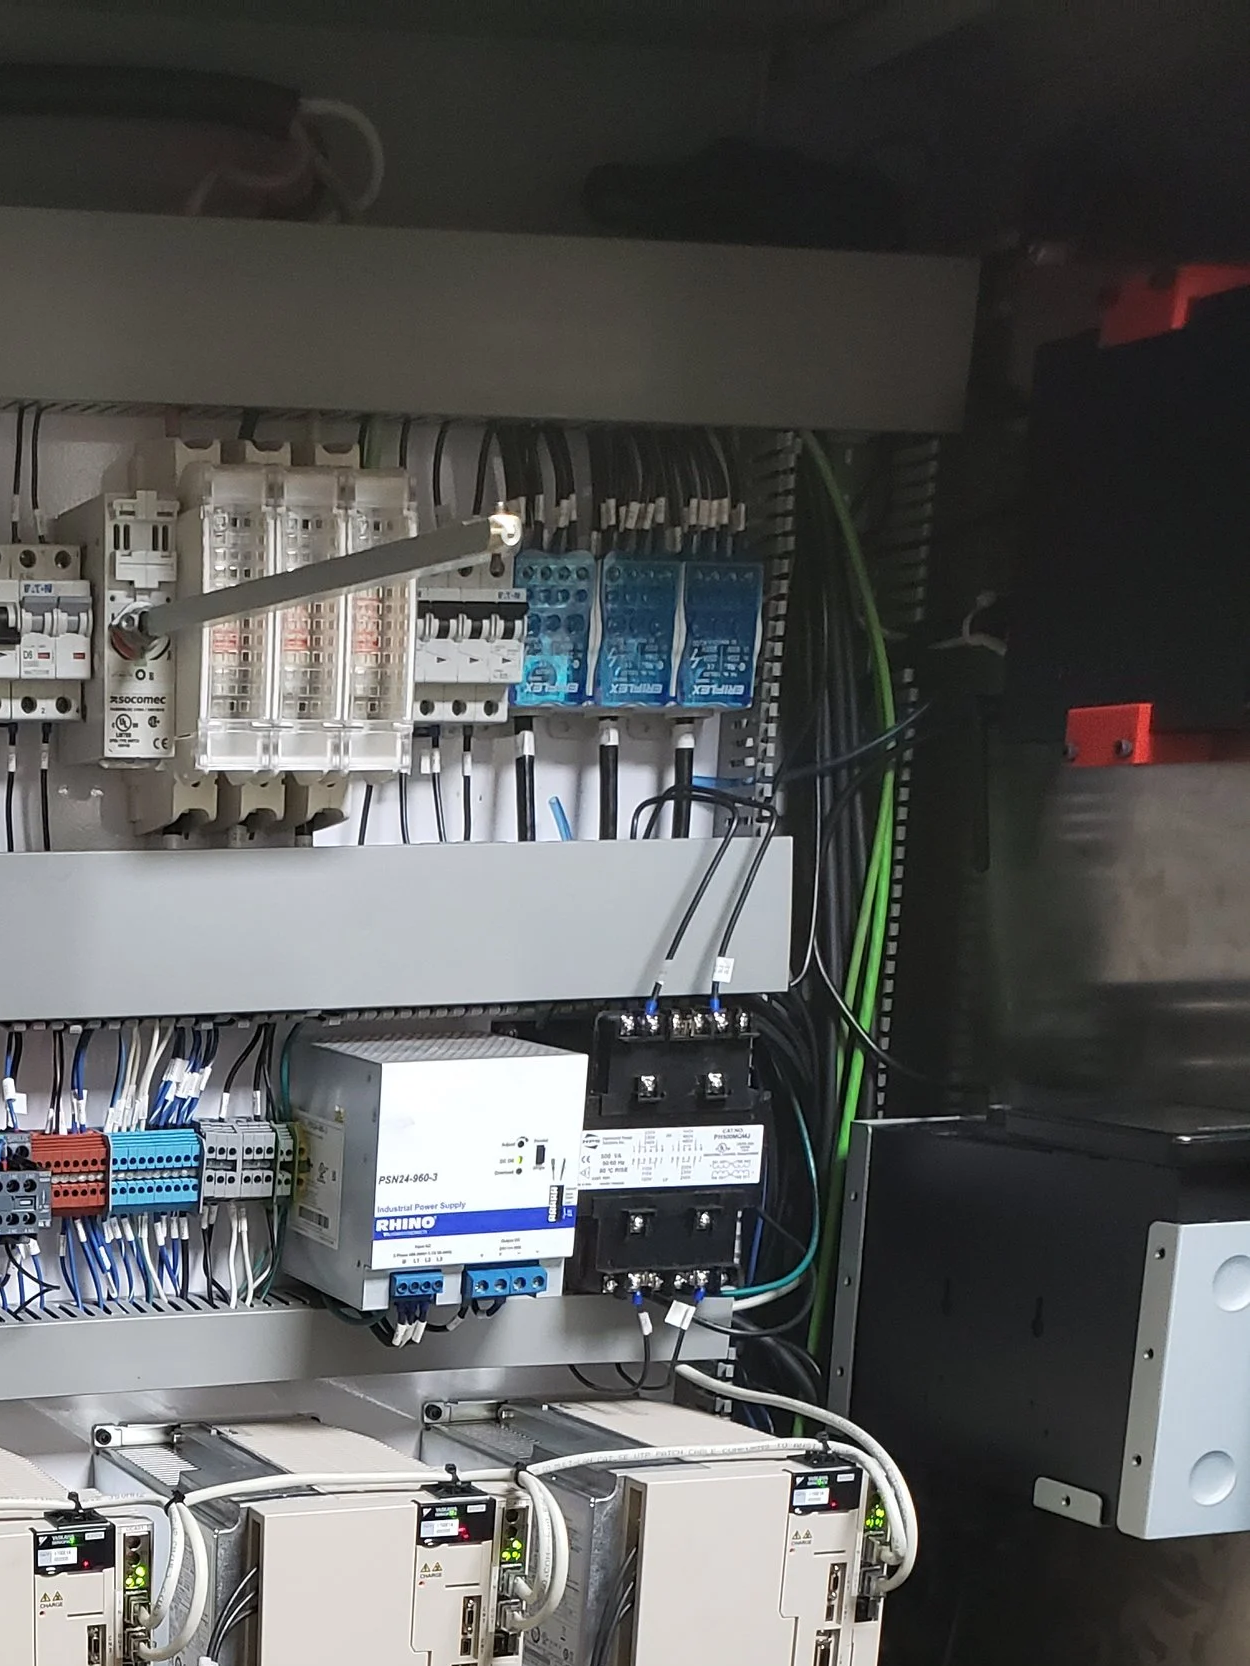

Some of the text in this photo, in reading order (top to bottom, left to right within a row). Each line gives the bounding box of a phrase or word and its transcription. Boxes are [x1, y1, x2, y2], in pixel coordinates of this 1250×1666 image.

[523, 682, 580, 694] ERIFLEX
[608, 682, 664, 695] ERIFLEX
[691, 683, 746, 696] ERIFLEX
[118, 695, 167, 704] socomec
[378, 1173, 438, 1185] PSN24-960-3
[377, 1200, 467, 1214] Industrial Power Supply
[375, 1215, 436, 1233] RHINO
[39, 1601, 64, 1609] CHARGE
